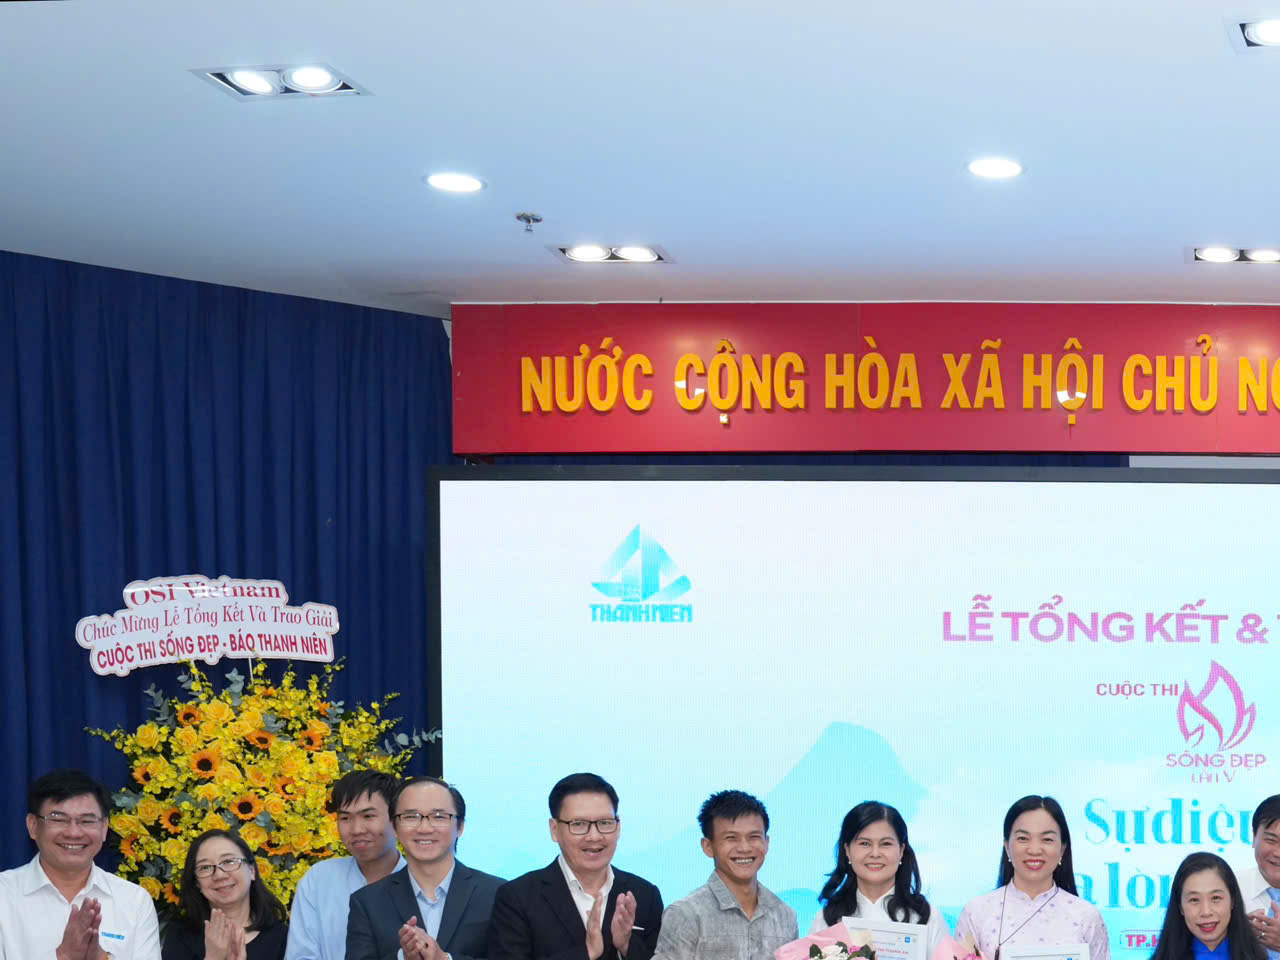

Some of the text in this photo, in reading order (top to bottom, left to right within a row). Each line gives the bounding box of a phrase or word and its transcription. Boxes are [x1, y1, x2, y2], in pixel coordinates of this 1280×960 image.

[521, 337, 654, 412] NƯỚC
[674, 339, 806, 424] CỘNG
[824, 336, 923, 409] HÒA
[940, 338, 1006, 409] XÃ
[1022, 337, 1104, 425] HỘI
[1122, 333, 1218, 413] CHỦ
[130, 581, 282, 607] OSI Vietnam
[82, 602, 333, 643] Chúc Mừng Lễ Tổng Kết Và Trao Giải
[942, 594, 995, 643] LỄ
[1001, 594, 1135, 643] TỔNG
[1145, 598, 1229, 644] KẾT
[1235, 613, 1271, 645] &
[96, 645, 135, 671] CUỘC
[136, 642, 157, 661] THI
[160, 631, 194, 657] SỐNG
[196, 634, 220, 659] ĐẸP
[229, 628, 256, 652] BÁO
[257, 633, 299, 653] THANH
[301, 632, 328, 656] NIÊN
[1096, 680, 1179, 700] CUỘC THI
[1084, 797, 1151, 853] Sự
